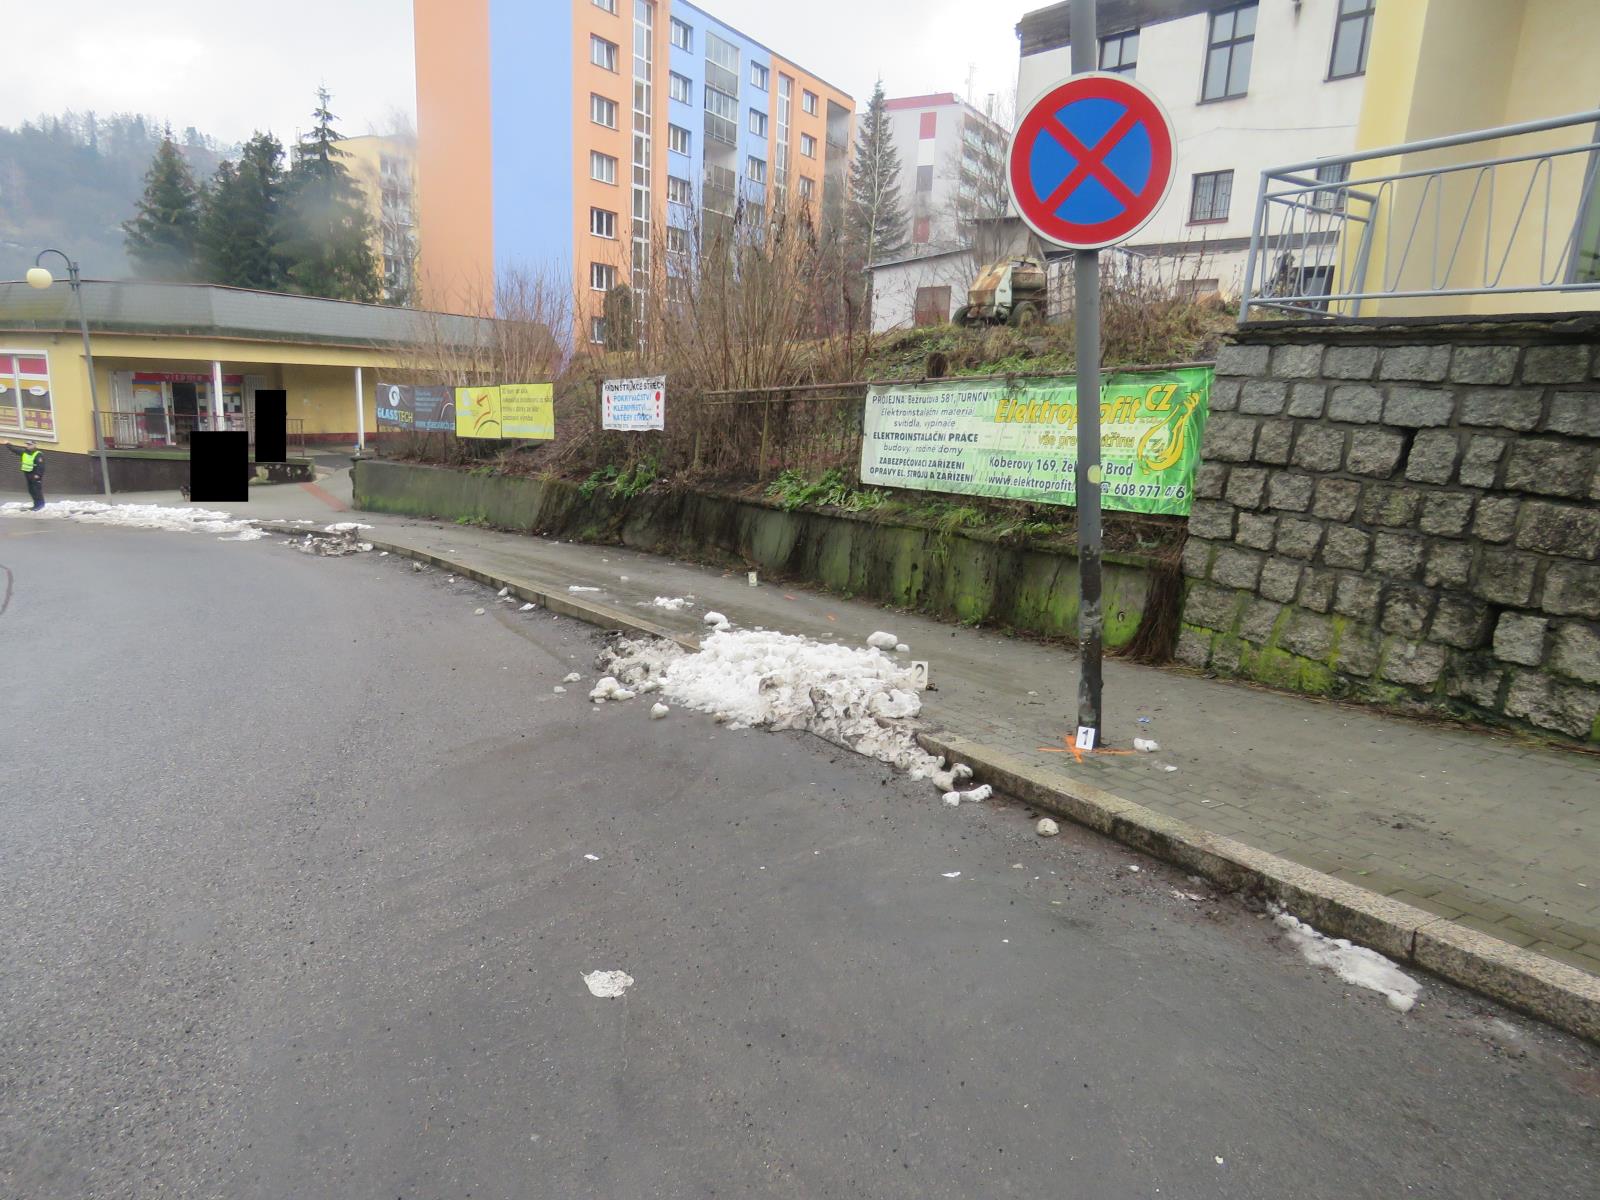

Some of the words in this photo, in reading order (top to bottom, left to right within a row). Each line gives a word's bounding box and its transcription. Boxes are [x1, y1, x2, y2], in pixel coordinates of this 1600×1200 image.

[958, 391, 989, 403] TURNOV
[1145, 383, 1179, 411] CZ
[994, 396, 1141, 430] Elektropofit
[937, 444, 963, 457] domy
[989, 455, 1034, 473] Koberovy
[1105, 462, 1134, 476] Brod
[929, 471, 936, 479] A
[1114, 483, 1136, 497] 608
[1139, 484, 1161, 498] 977
[914, 663, 925, 681] 2
[1081, 729, 1091, 747] 1
